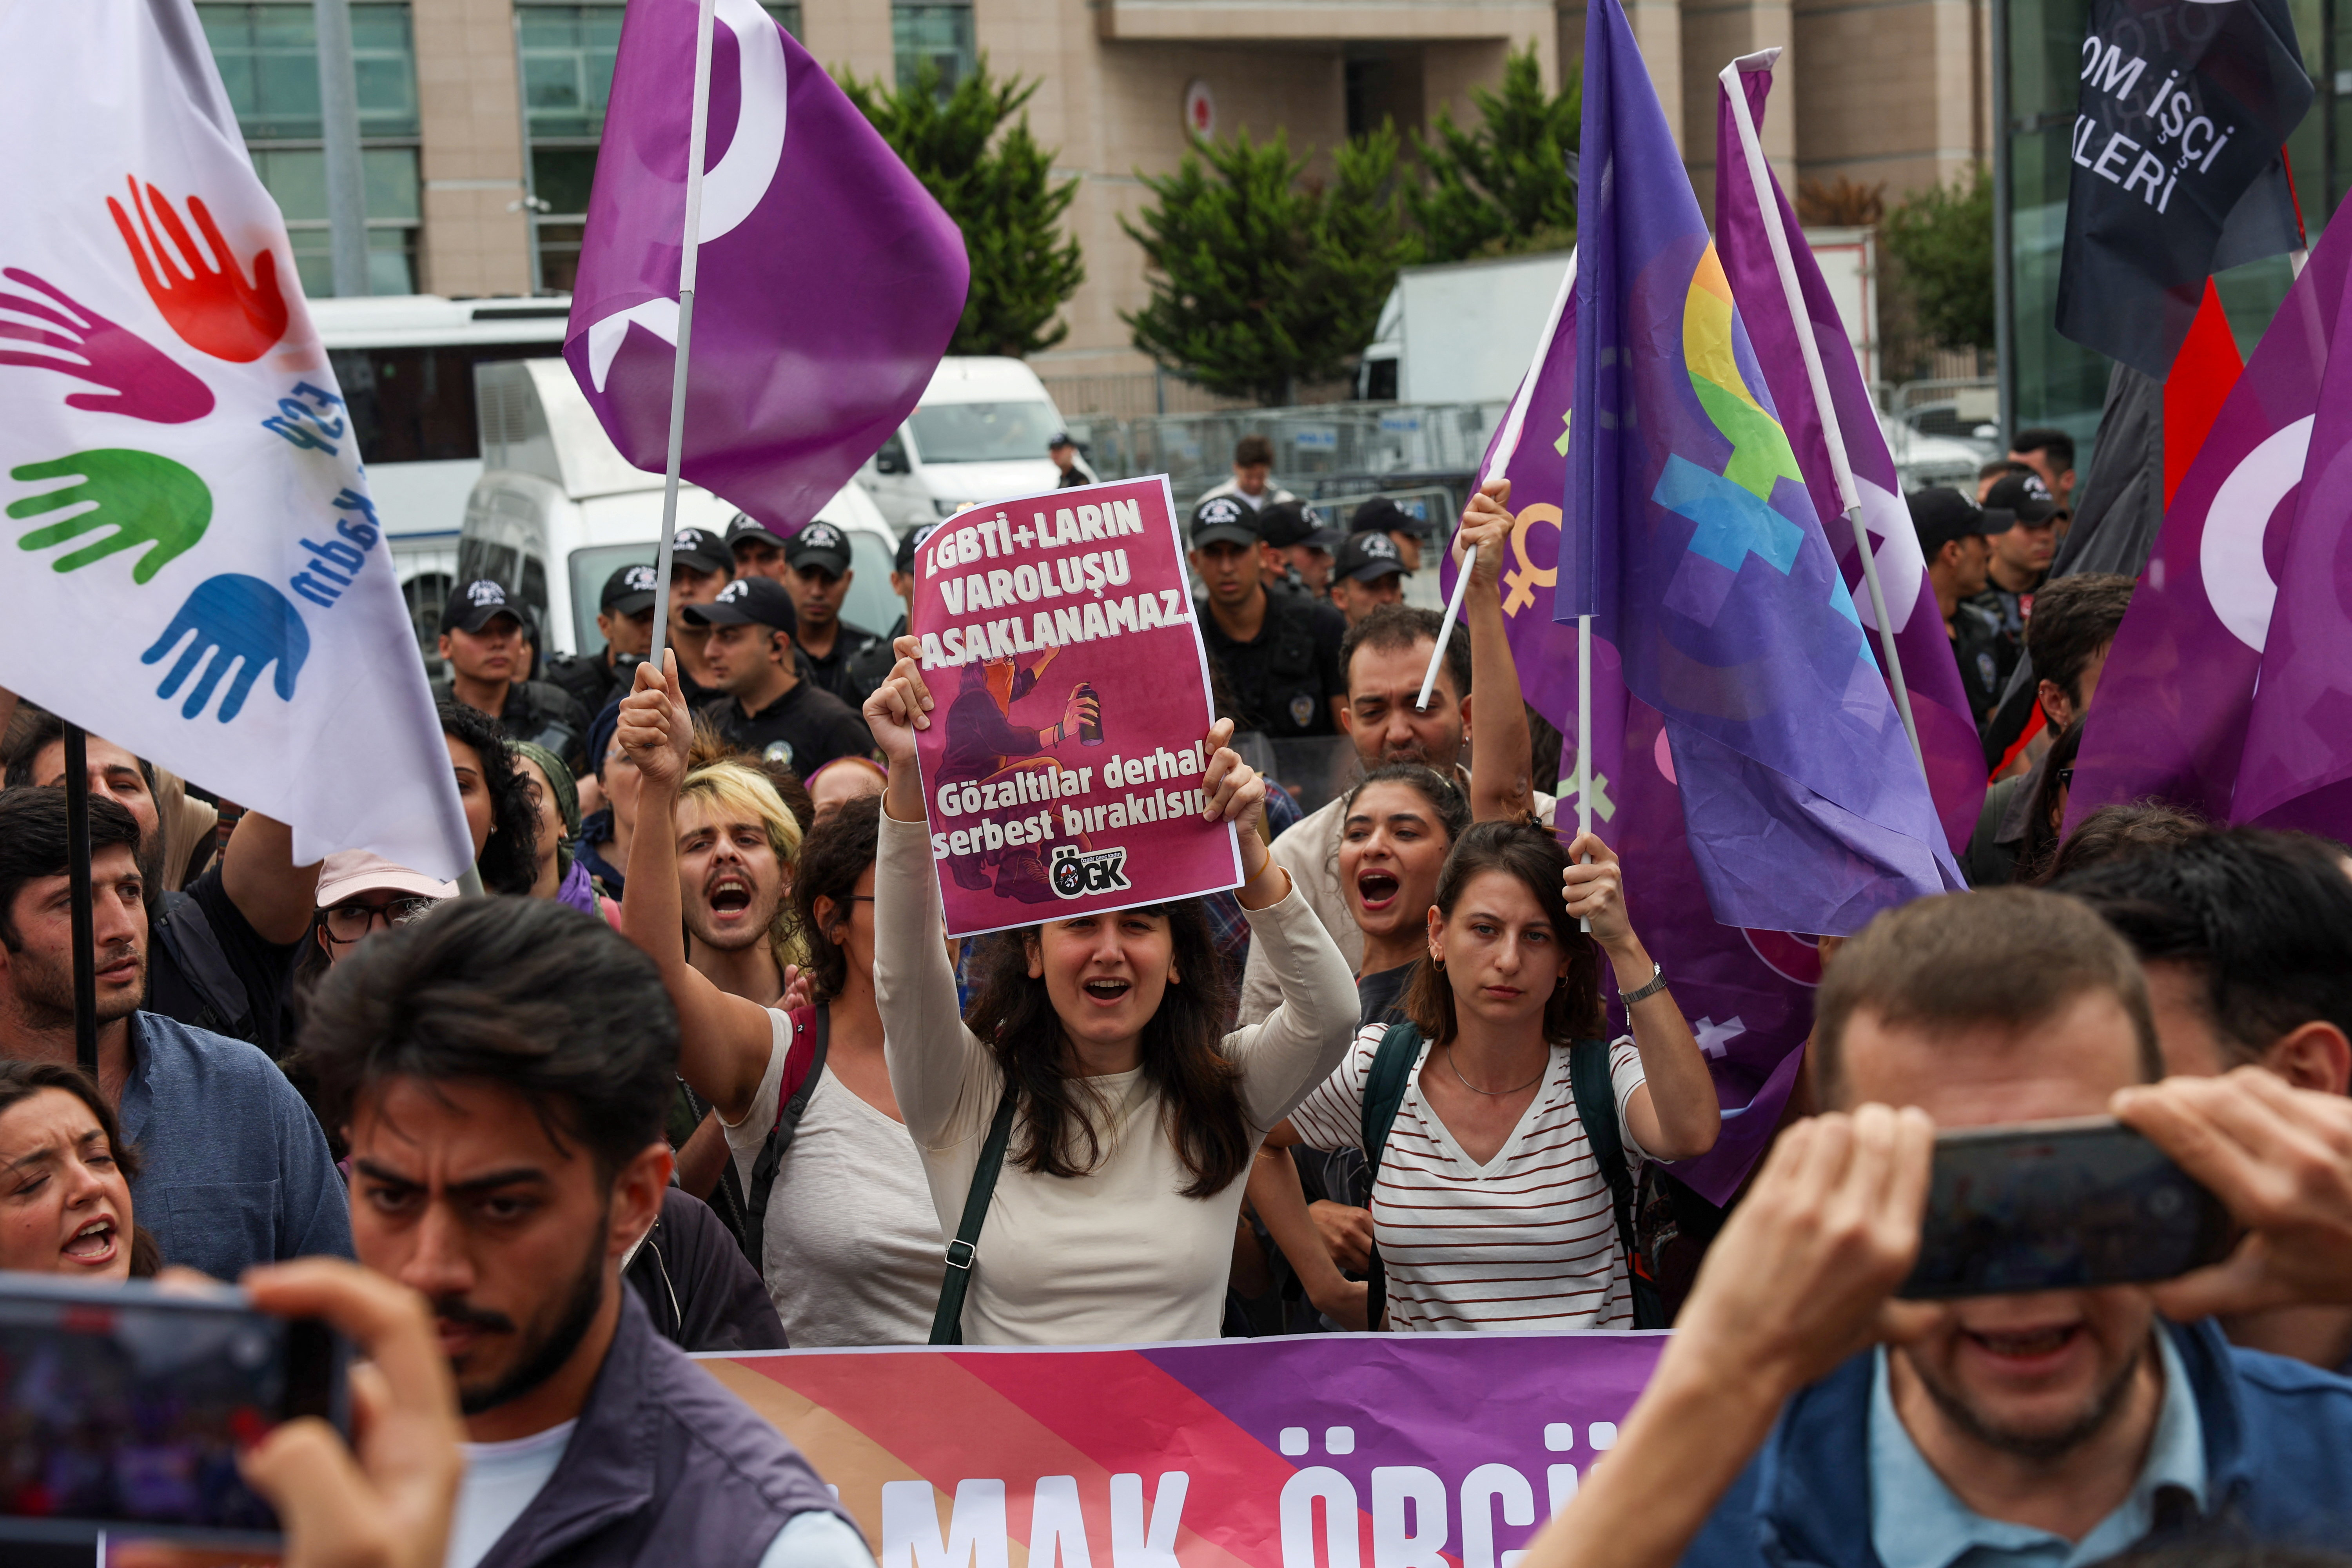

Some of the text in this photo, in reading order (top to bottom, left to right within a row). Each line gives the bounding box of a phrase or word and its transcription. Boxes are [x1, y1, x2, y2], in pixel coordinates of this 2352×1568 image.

[2145, 69, 2234, 174] İŞÇİ
[2071, 114, 2178, 214] LERİ
[926, 499, 1143, 579] LGBTİ+LARIN
[940, 549, 1130, 615] VAROLUŞU
[916, 589, 1191, 671] ASAKLANAMAZ.
[938, 739, 1206, 817] Gözaltılar derhal
[932, 788, 1212, 860] serbest bırakılsın
[1053, 849, 1127, 895] ÖGK
[825, 1471, 1190, 1568] MAK
